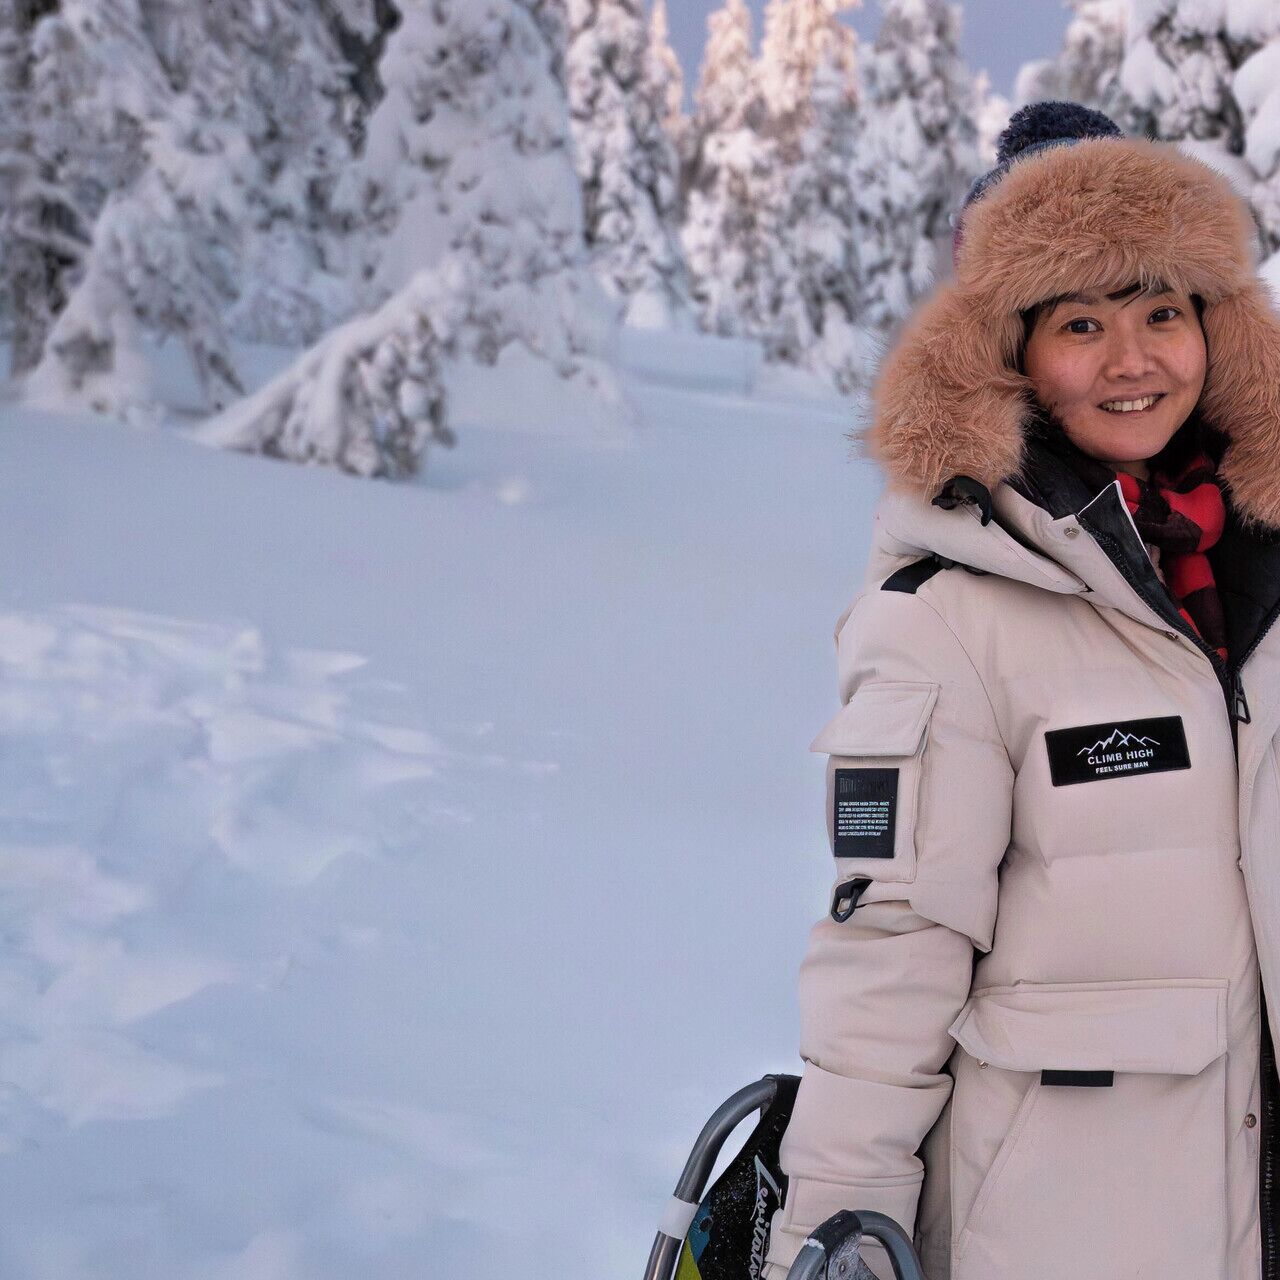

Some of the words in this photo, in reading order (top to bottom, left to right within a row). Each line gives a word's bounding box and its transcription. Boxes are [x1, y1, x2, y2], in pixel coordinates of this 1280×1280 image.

[1087, 752, 1122, 765] CLIMB
[1126, 749, 1154, 760] HIGH
[1095, 766, 1113, 774] FEEL
[1114, 763, 1132, 771] SURE
